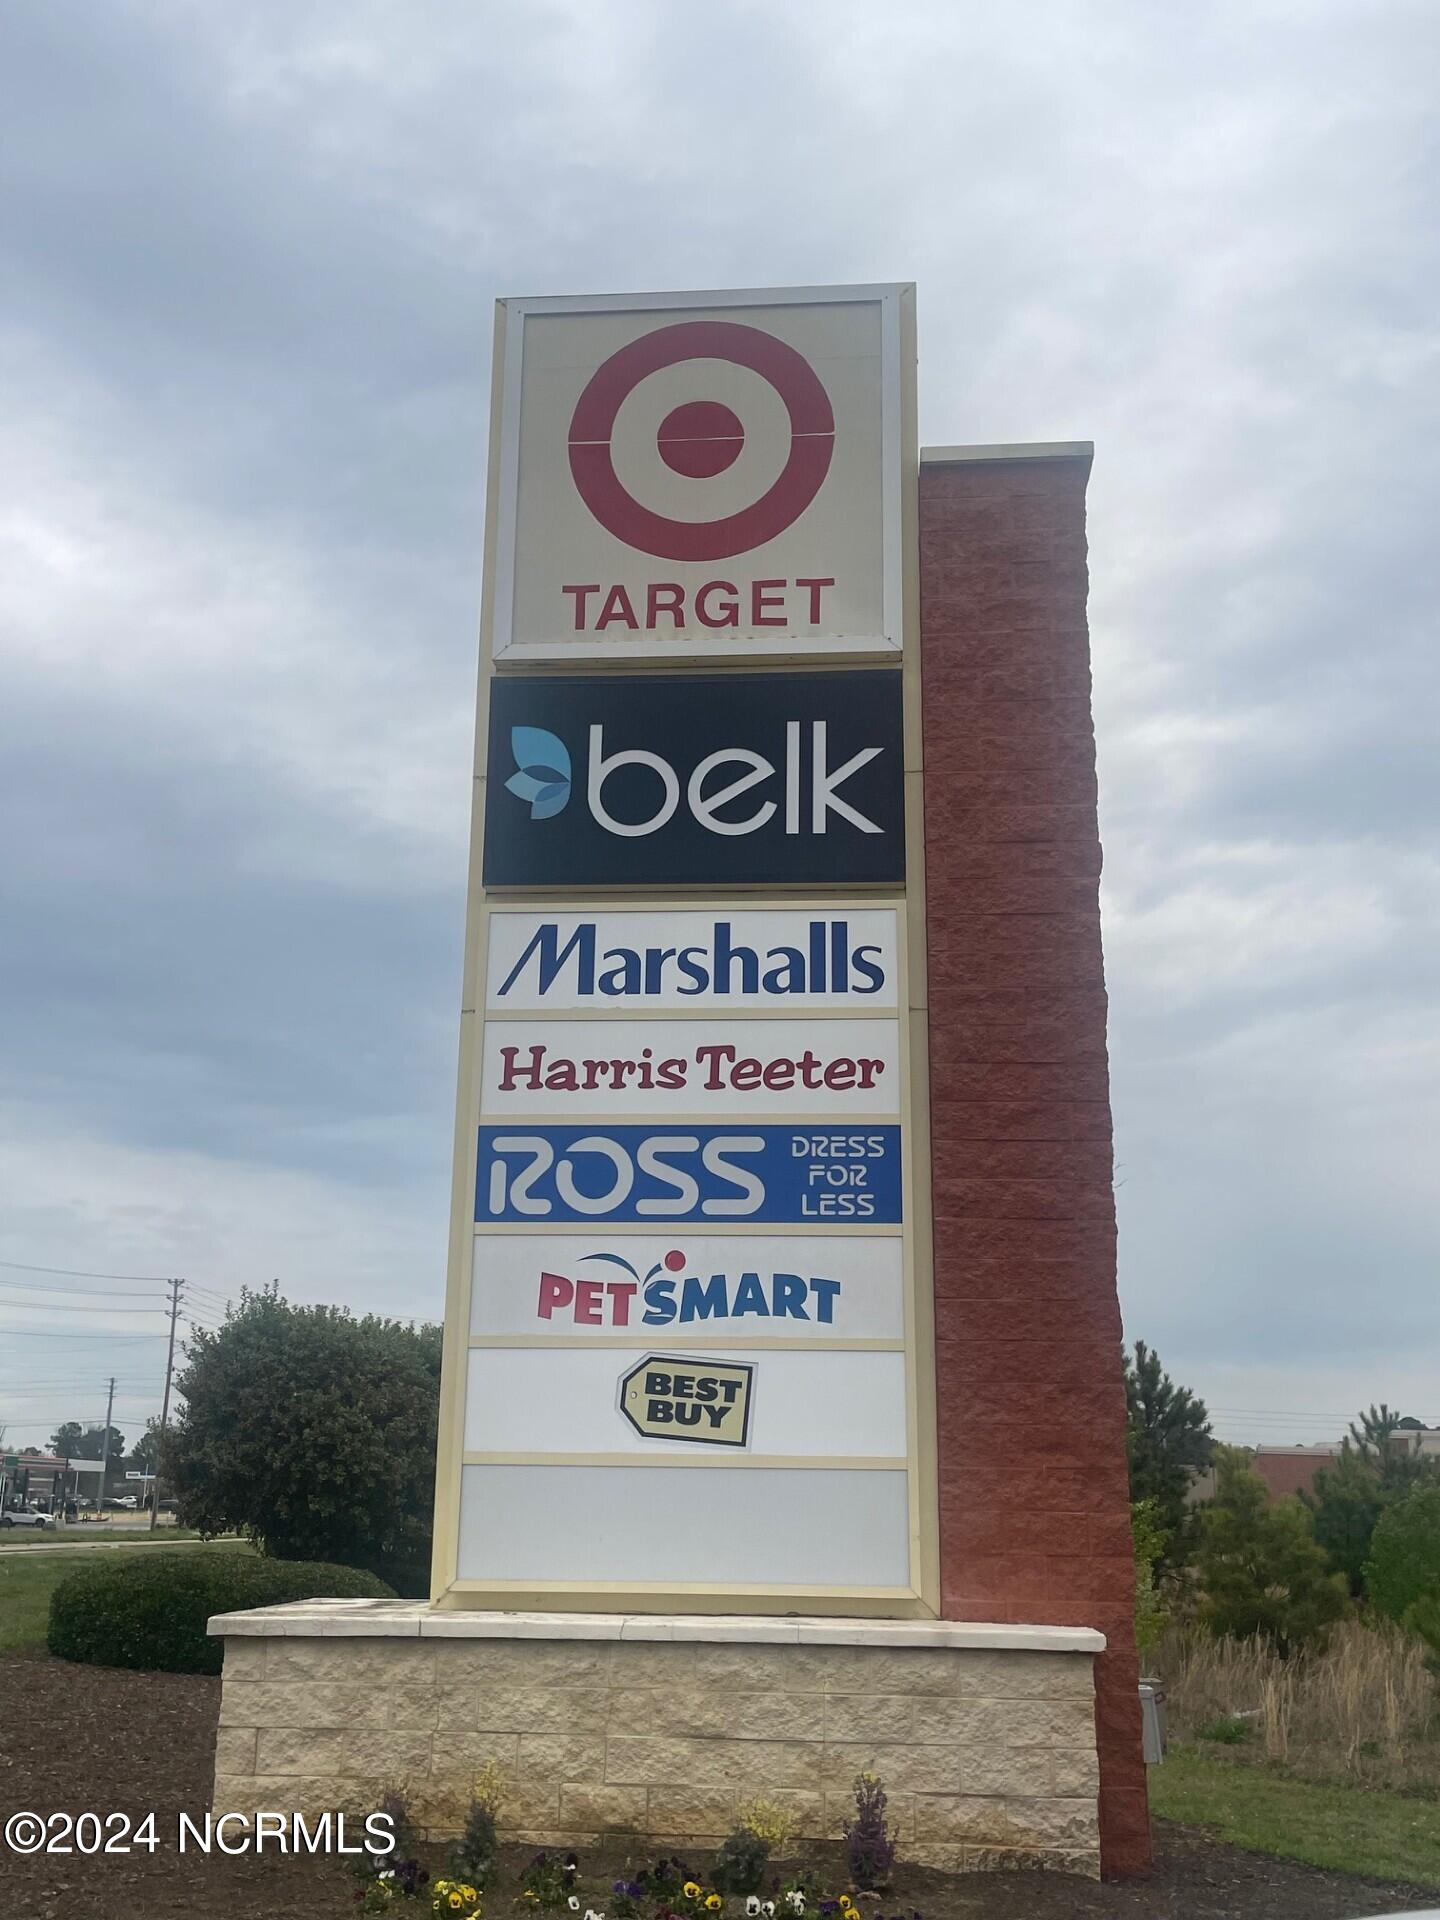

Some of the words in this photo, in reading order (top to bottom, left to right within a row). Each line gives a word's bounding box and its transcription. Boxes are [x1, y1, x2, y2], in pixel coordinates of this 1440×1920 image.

[562, 578, 835, 630] TARGET
[587, 720, 885, 837] belk
[497, 921, 885, 996] Marshalls
[498, 1045, 688, 1091] Harris
[695, 1044, 885, 1091] Teeter
[792, 1136, 885, 1158] DRESS
[489, 1136, 766, 1215] ROSS
[809, 1164, 868, 1186] FOR
[802, 1194, 875, 1216] LESS
[645, 1372, 742, 1404] BEST
[646, 1399, 732, 1428] BUY
